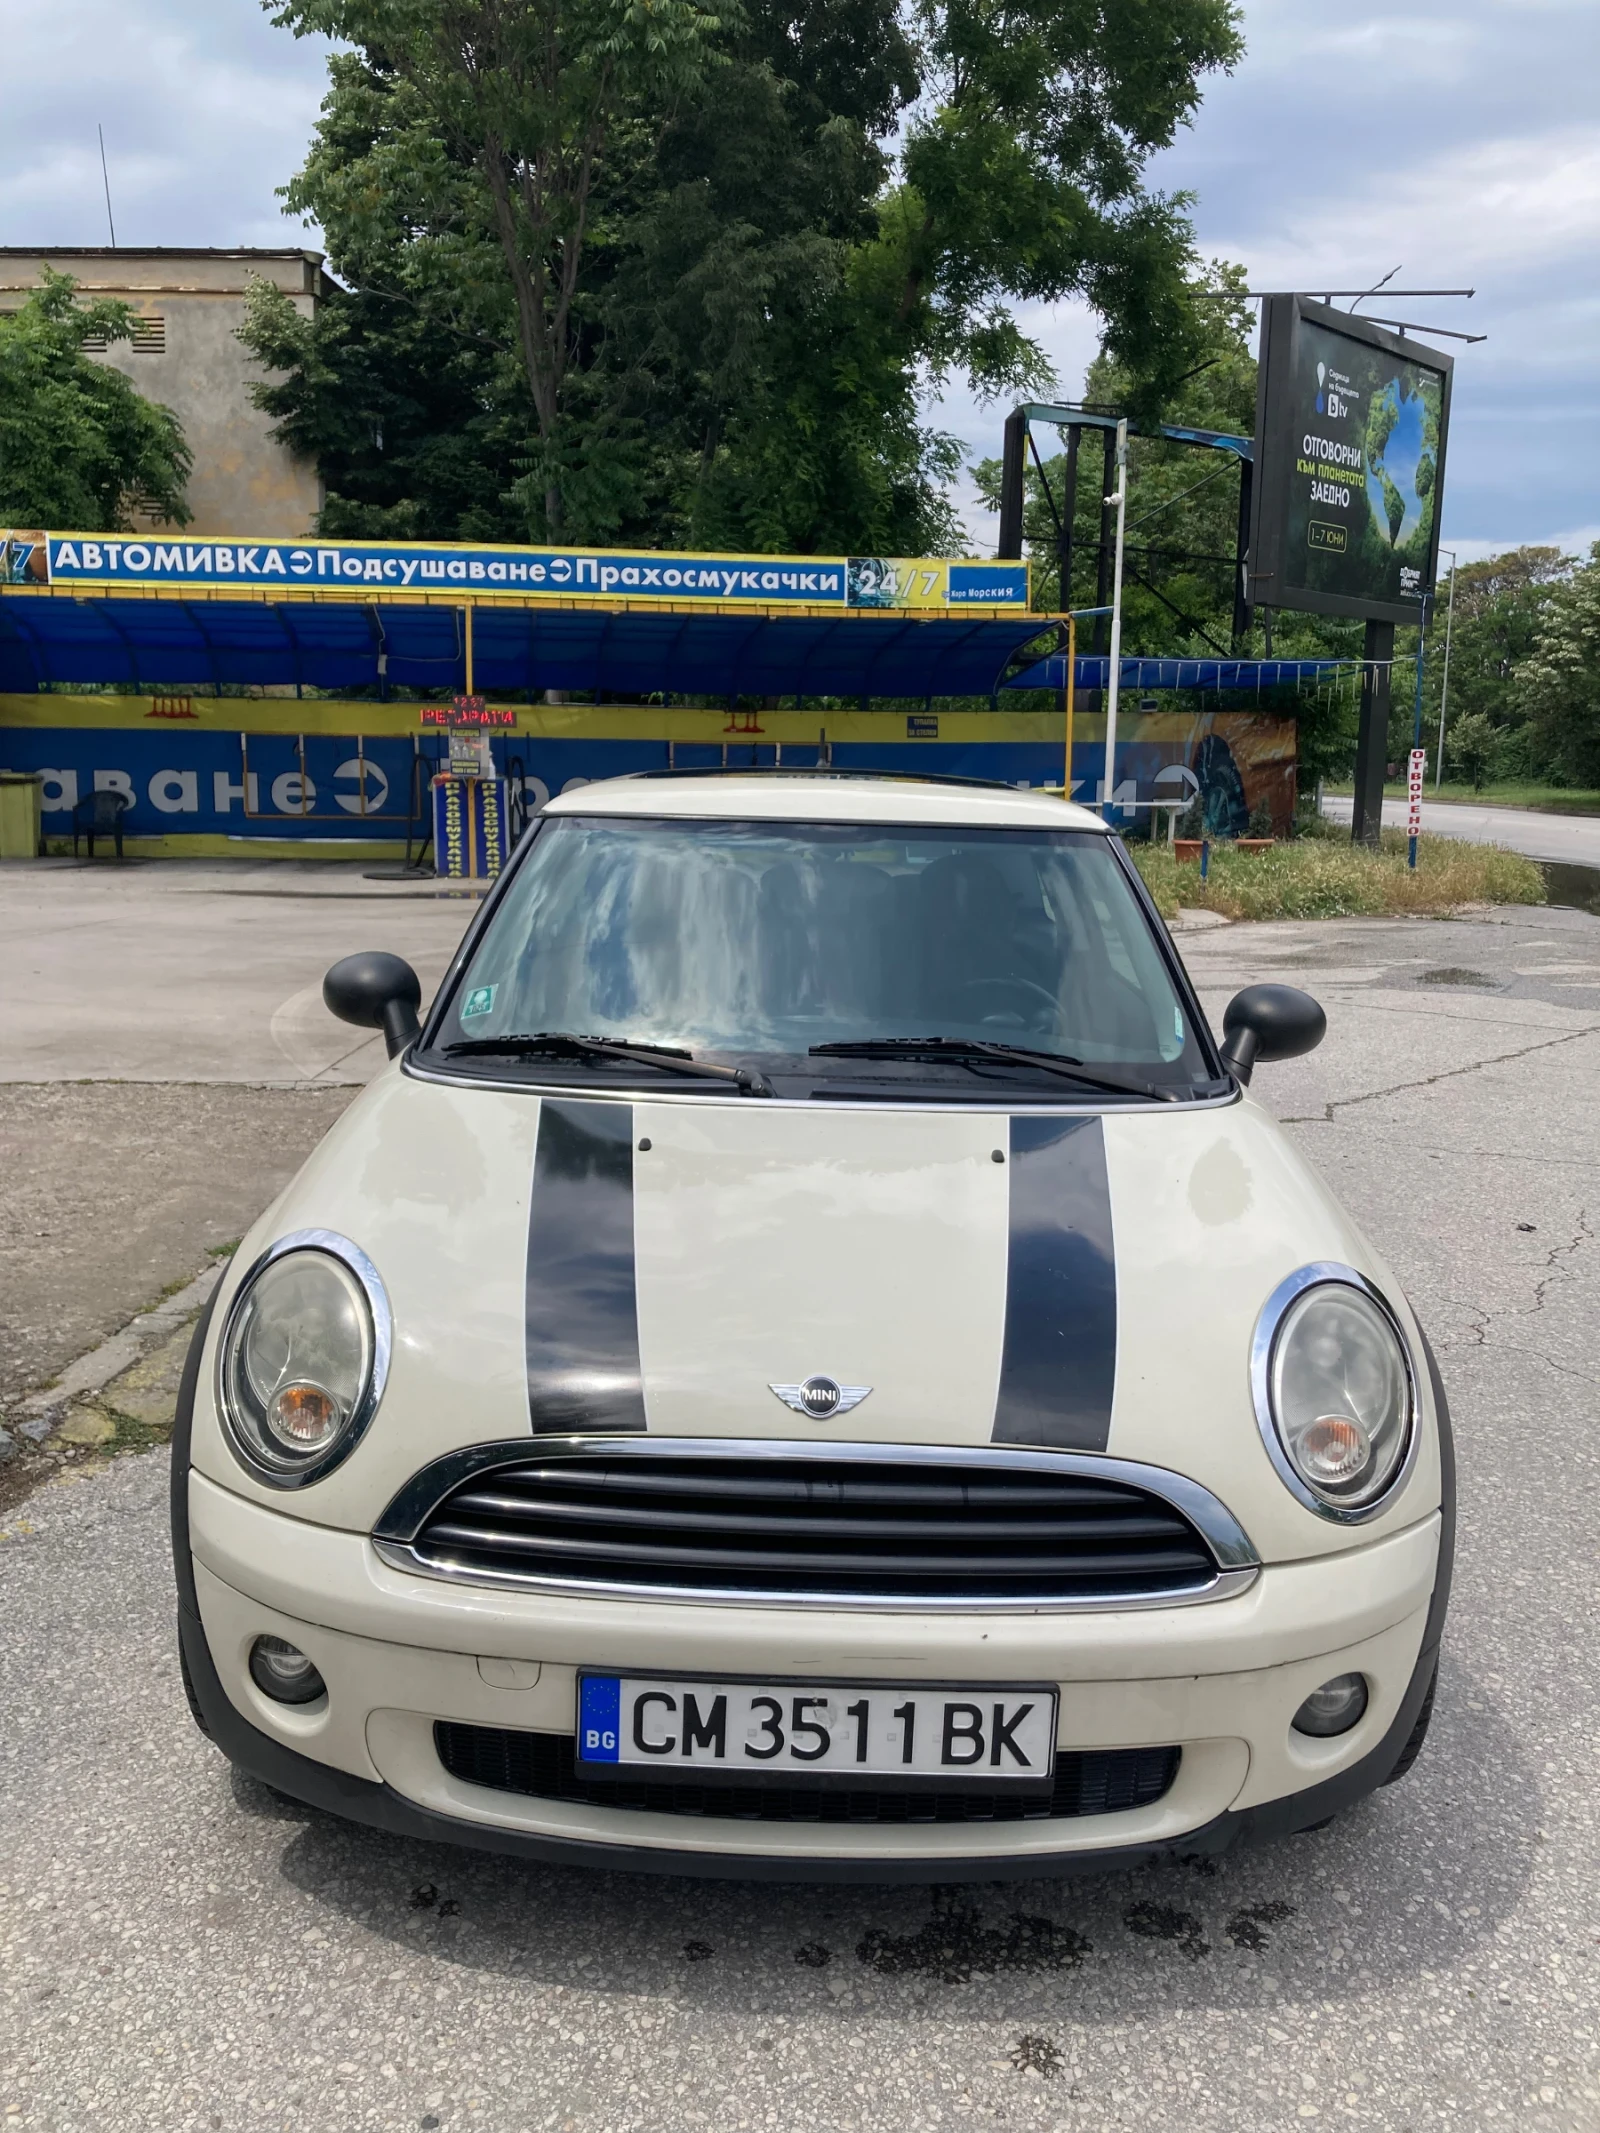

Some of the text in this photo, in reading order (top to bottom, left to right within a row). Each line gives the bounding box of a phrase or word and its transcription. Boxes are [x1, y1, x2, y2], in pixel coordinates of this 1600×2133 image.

[1303, 434, 1361, 469] ОТГОВОРНИ
[1296, 458, 1365, 488] към планетата
[1310, 480, 1350, 508] ЗАЕДНО
[1326, 531, 1344, 546] ЮНИ
[54, 541, 839, 596] АВТОМИВКА Подсушаване Прахосмукачки
[858, 569, 940, 599] 24/7
[968, 587, 1014, 599] Морския
[0, 767, 318, 815] аване
[1407, 750, 1424, 836] ОТВОРЕНО
[445, 782, 462, 877] ПРАХОСМУКАЧКА
[804, 1388, 836, 1401] MINI
[586, 1729, 616, 1749] BG
[633, 1691, 1034, 1767] CM 3511 BK
